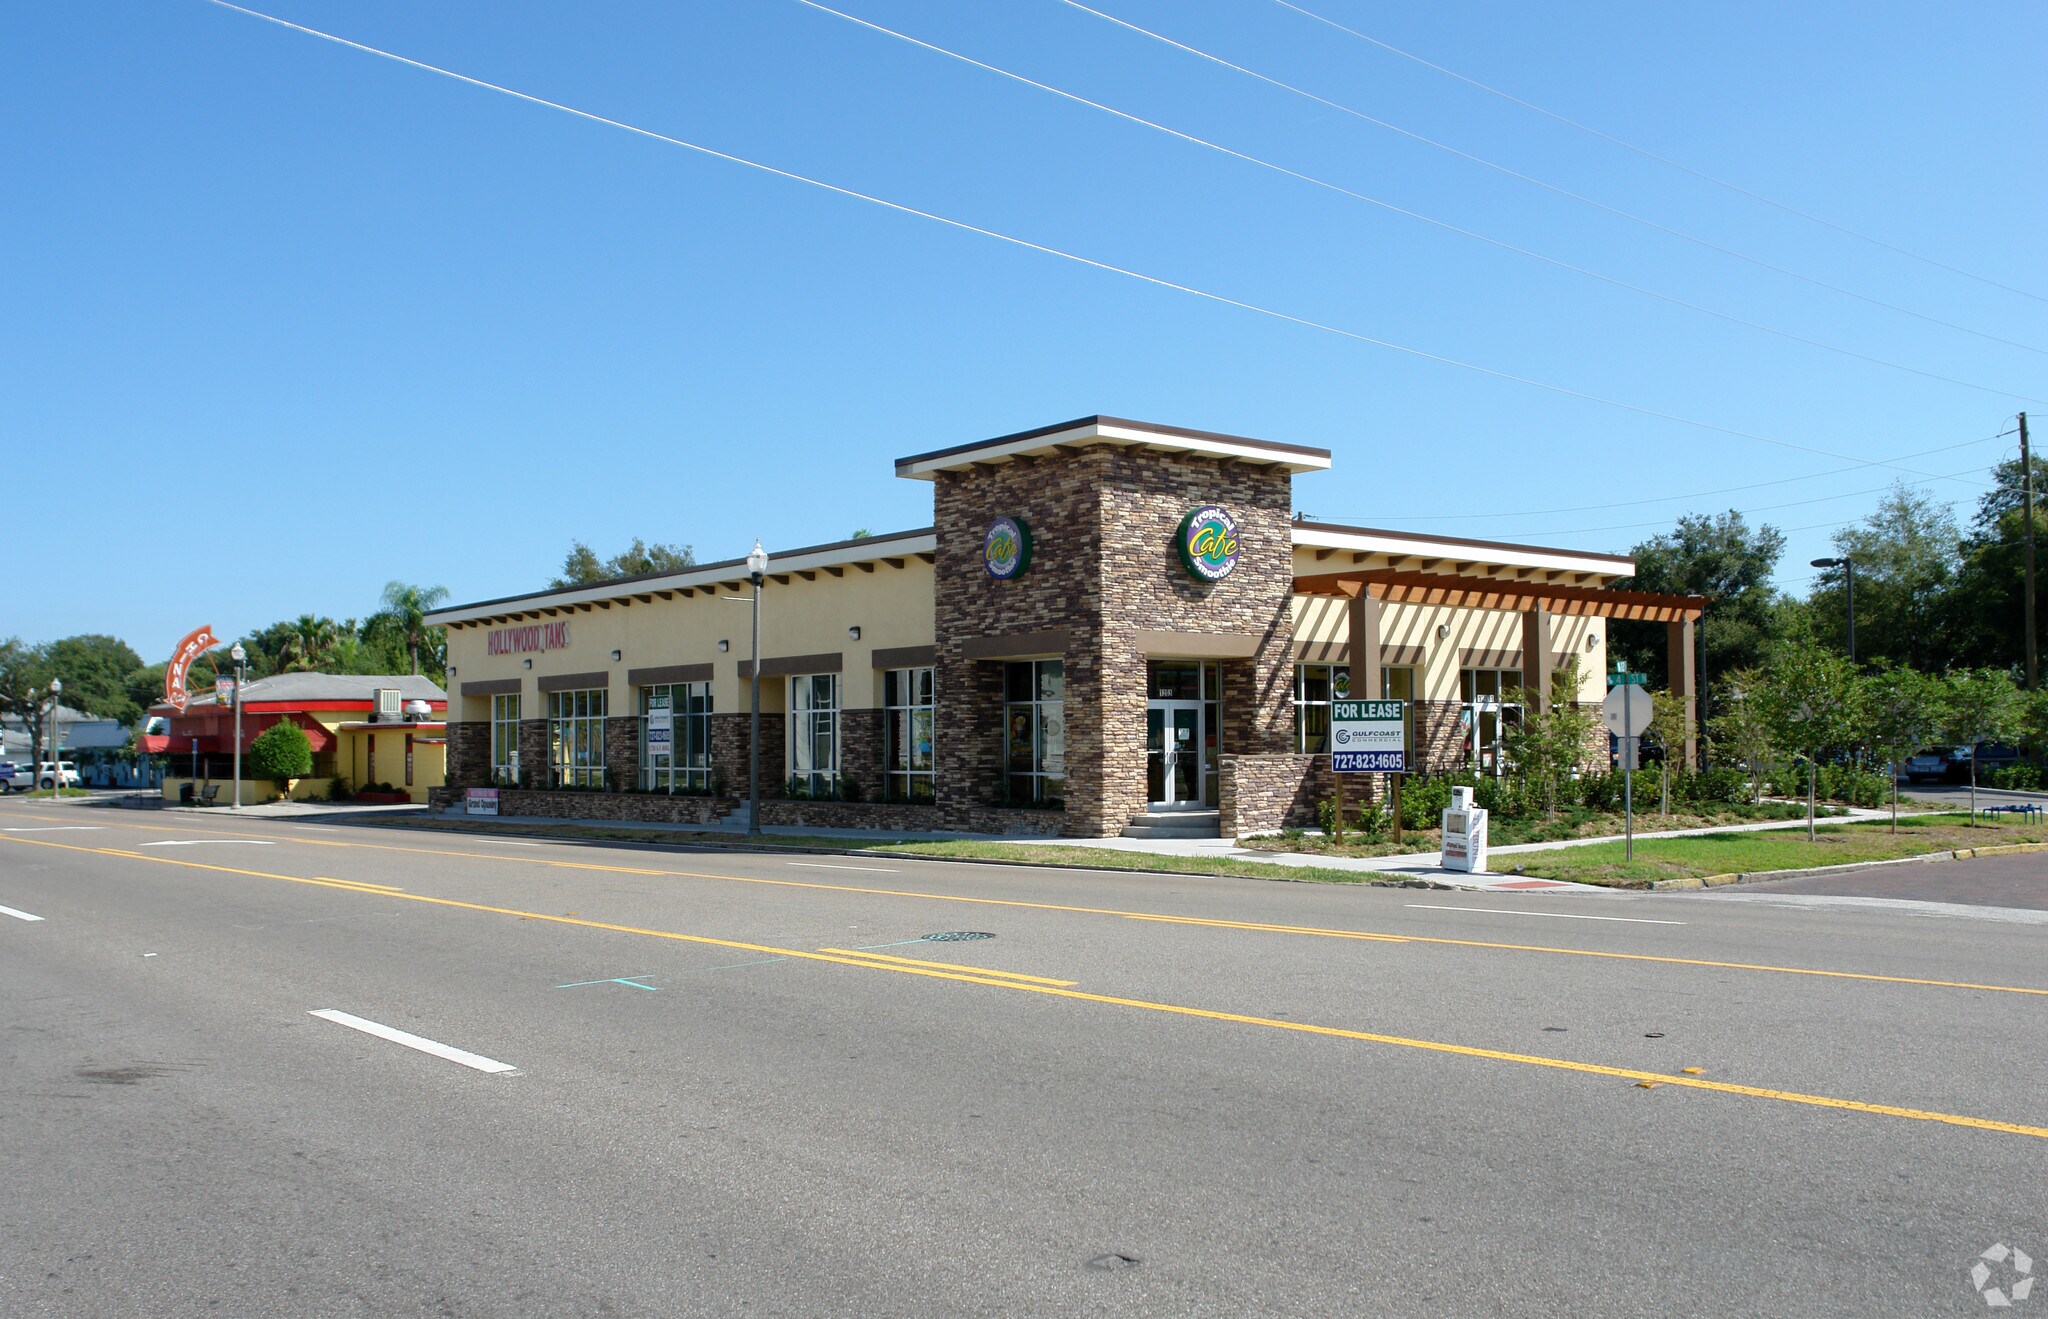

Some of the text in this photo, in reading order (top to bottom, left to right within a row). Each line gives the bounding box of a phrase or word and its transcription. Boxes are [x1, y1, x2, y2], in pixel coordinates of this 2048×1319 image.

[1191, 508, 1235, 531] Tropical
[988, 521, 1017, 540] Tropical
[1189, 527, 1239, 560] Café
[988, 558, 1017, 576] Smoothie
[1193, 556, 1236, 578] Smoothie
[487, 621, 568, 656] HOLLYWOOD TANS
[171, 632, 209, 690] CHINA
[1615, 674, 1621, 685] 4
[1631, 673, 1640, 684] ST
[1334, 703, 1400, 719] FOR LEASE
[1334, 754, 1403, 769] 727-823-1605
[468, 799, 480, 808] Grand
